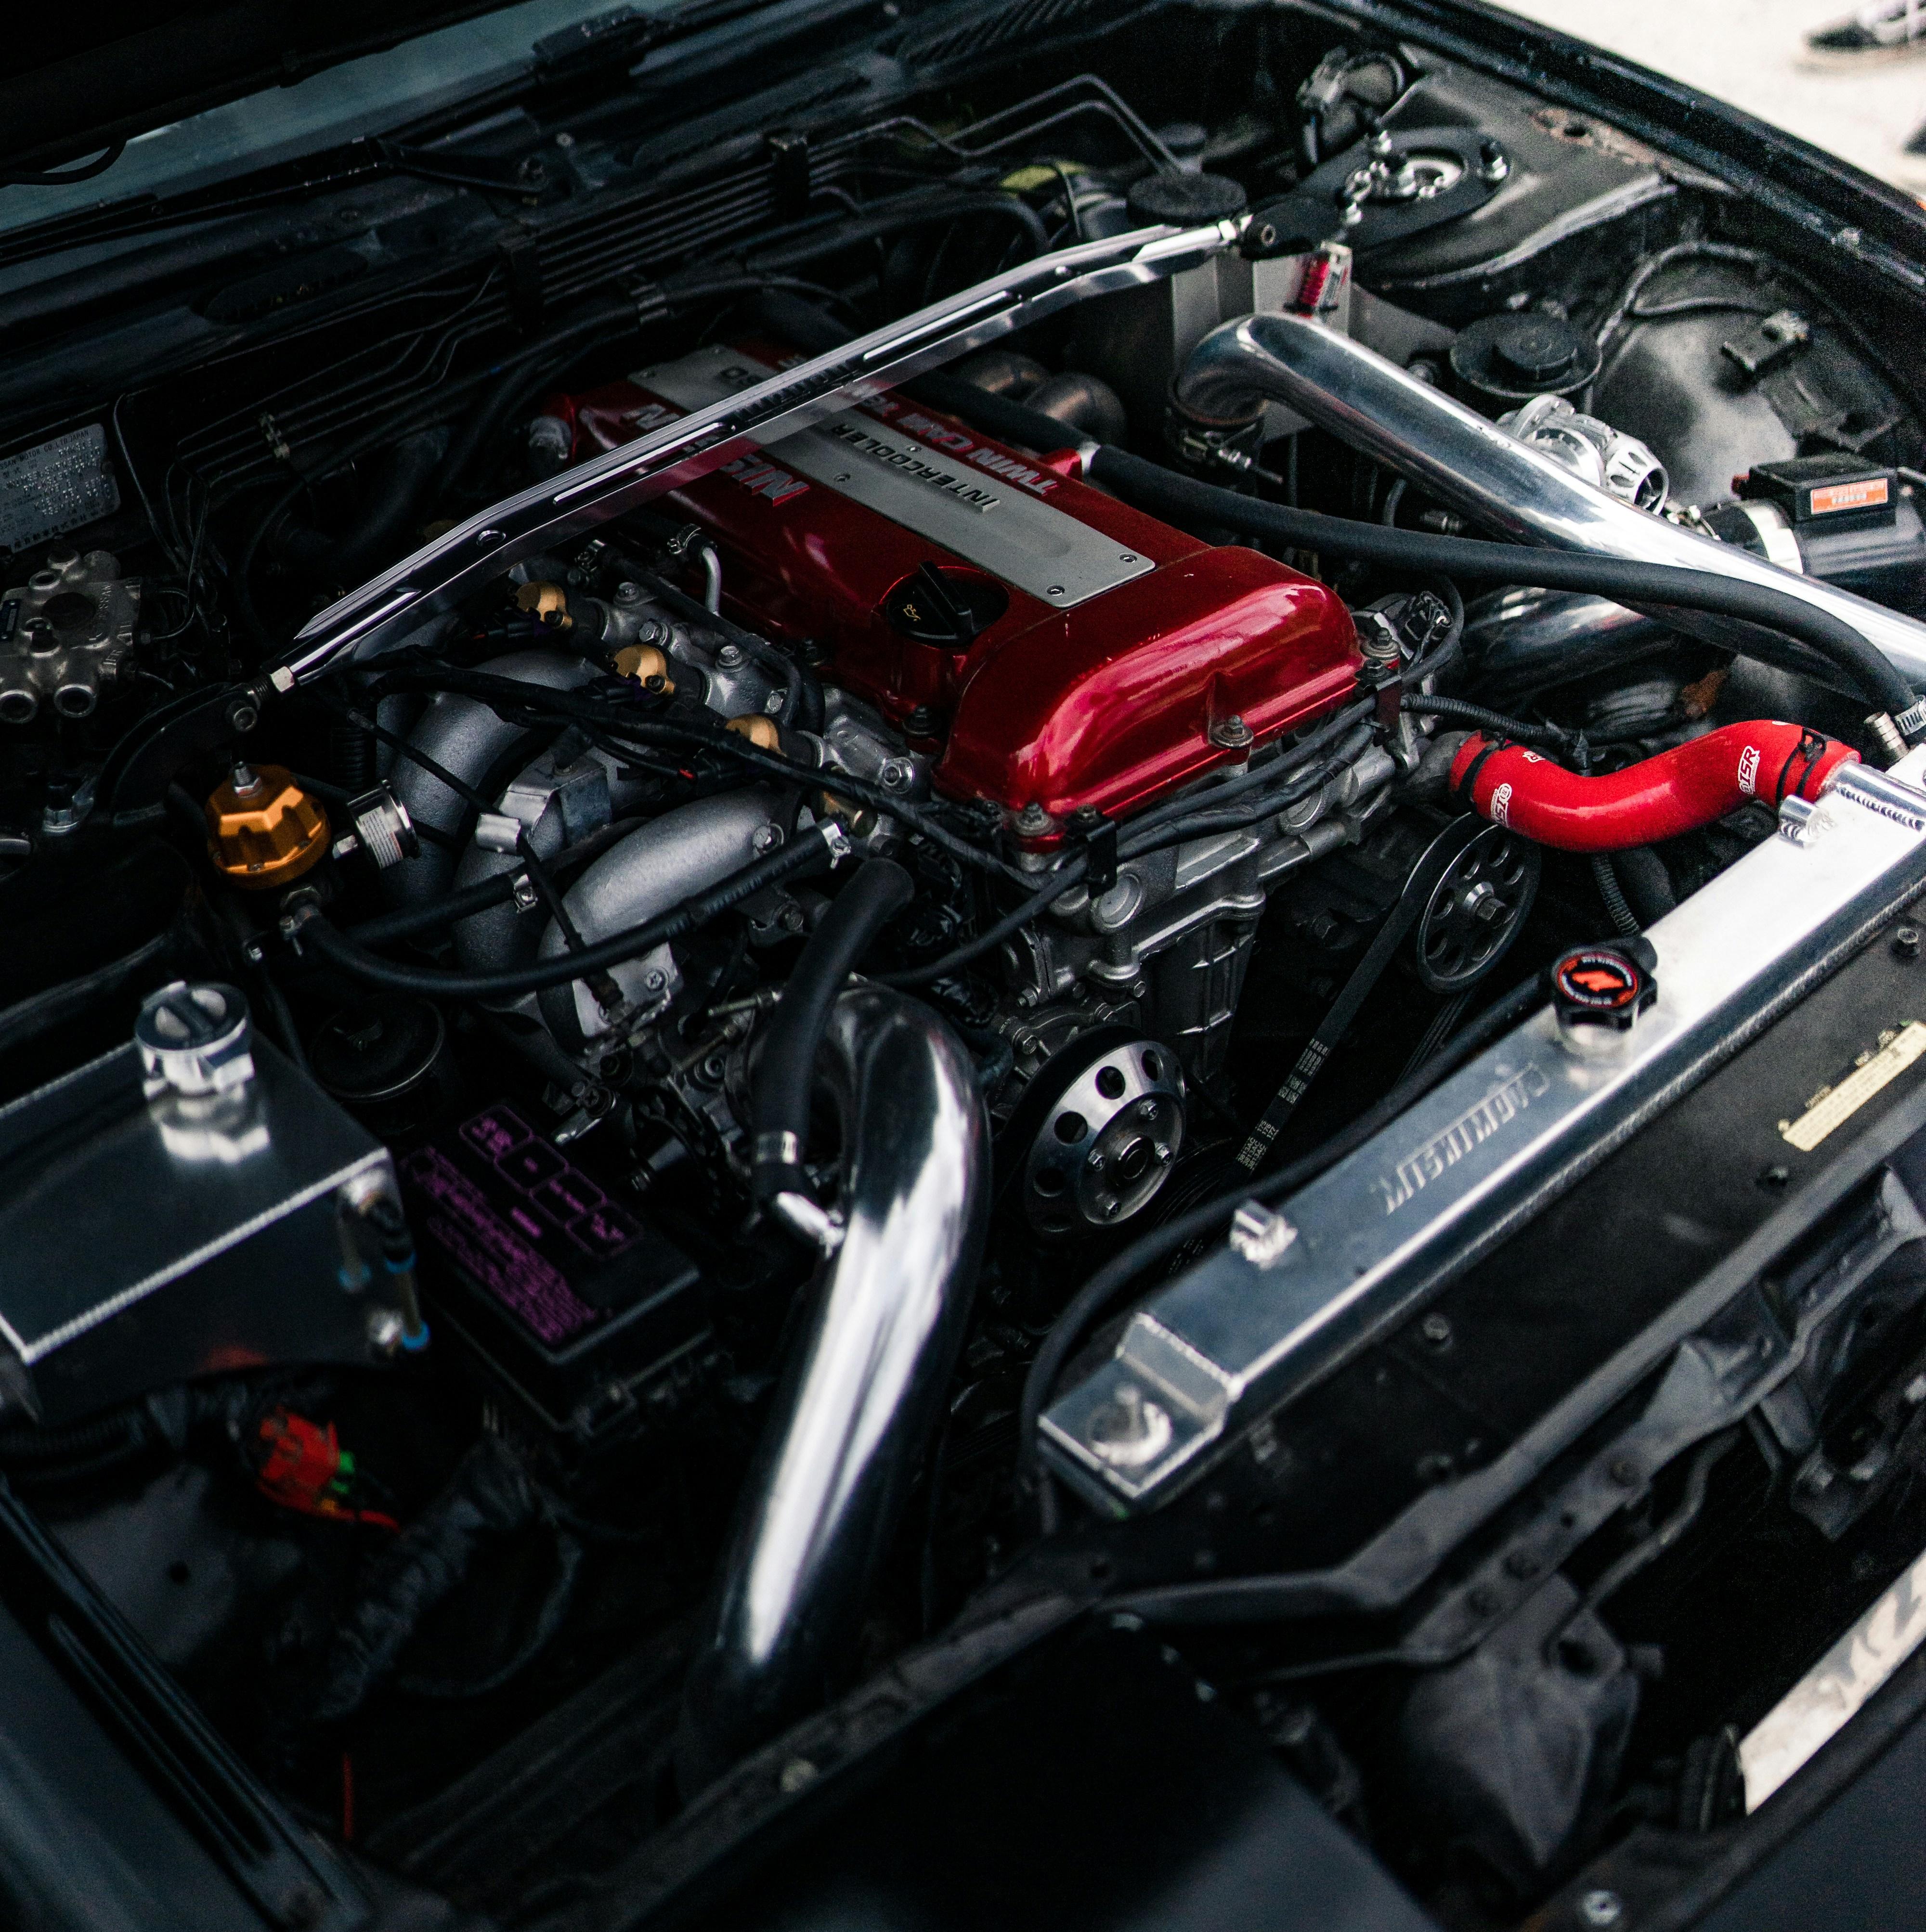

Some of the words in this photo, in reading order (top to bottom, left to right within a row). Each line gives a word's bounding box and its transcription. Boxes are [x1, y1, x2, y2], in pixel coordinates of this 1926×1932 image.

[897, 412, 975, 453] CAM
[831, 422, 998, 507] INTERCOOLER
[968, 447, 1060, 496] TWIN
[1740, 748, 1756, 786] ISR
[1371, 1061, 1551, 1216] MISHIMOTO
